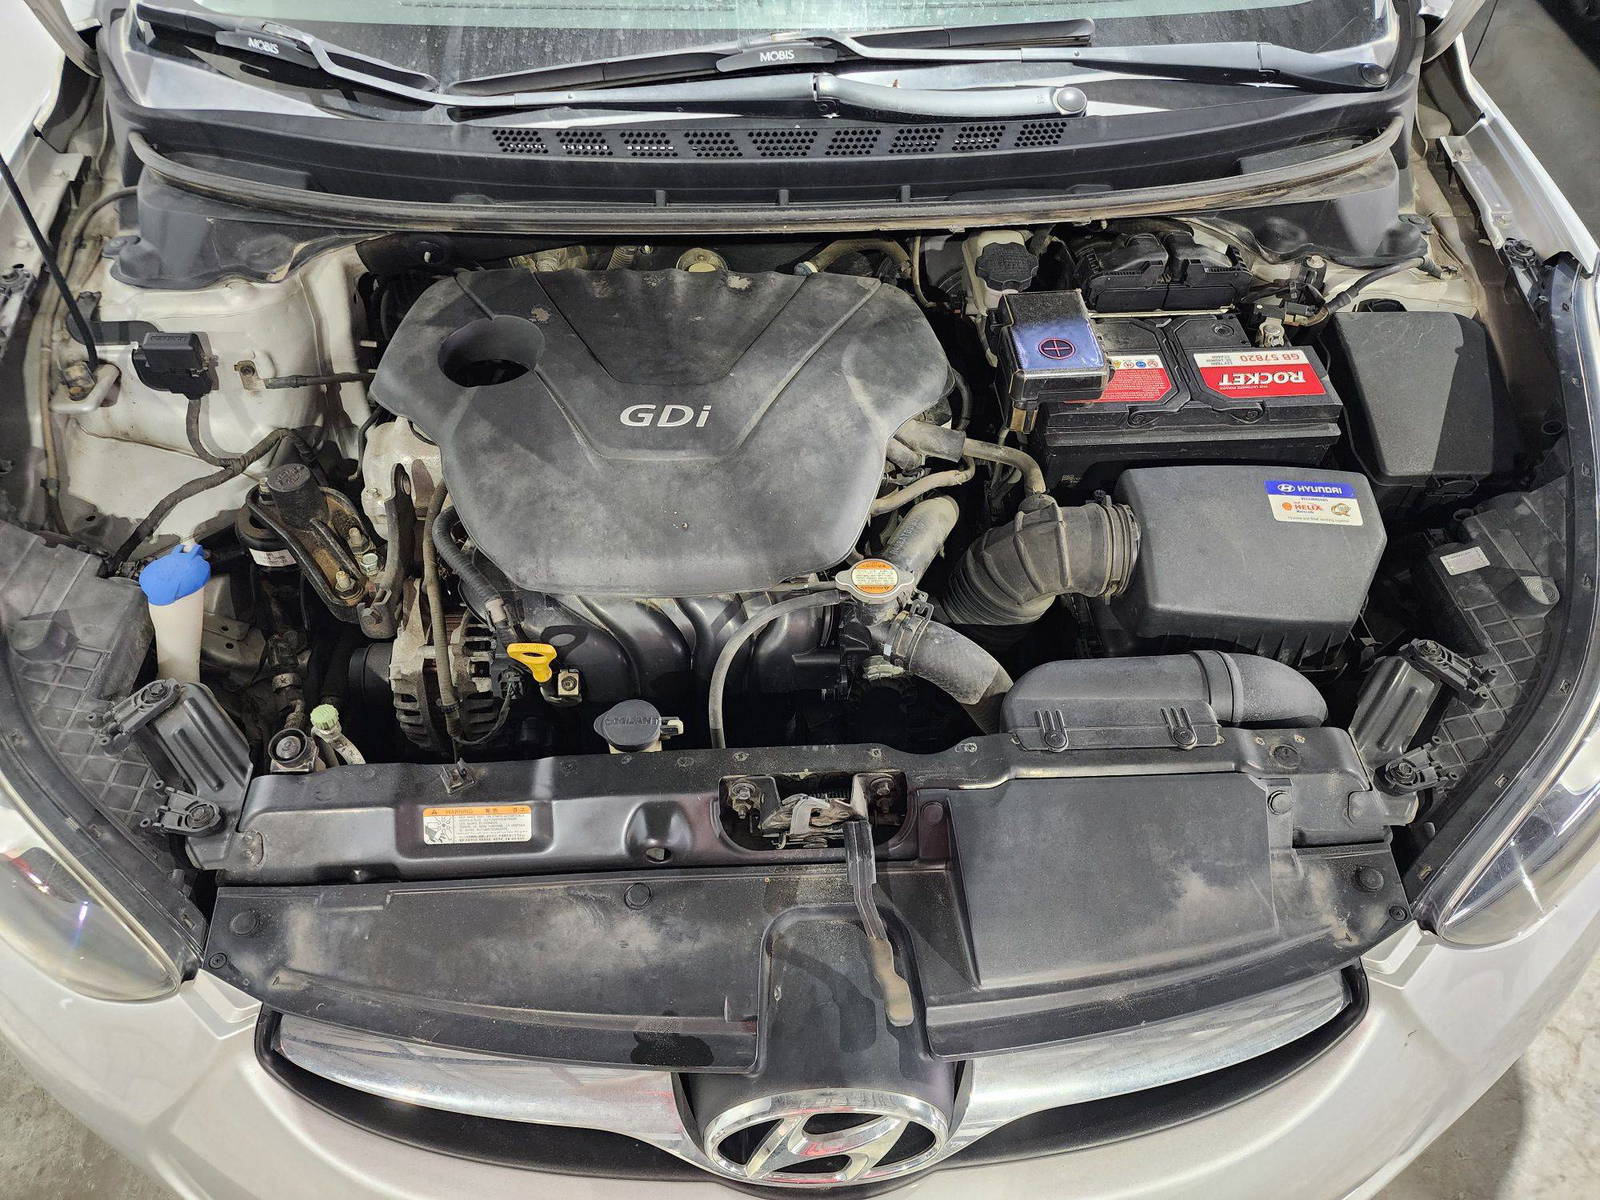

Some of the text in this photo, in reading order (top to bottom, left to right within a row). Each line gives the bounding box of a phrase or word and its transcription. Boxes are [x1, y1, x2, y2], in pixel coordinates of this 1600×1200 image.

[248, 37, 279, 54] MOBIS
[760, 50, 795, 62] MOBIS
[1240, 354, 1279, 363] 57820
[1283, 353, 1300, 361] GB
[1219, 371, 1306, 386] ROCKET
[619, 404, 712, 428] GDi
[1297, 485, 1343, 495] HYUNDAI
